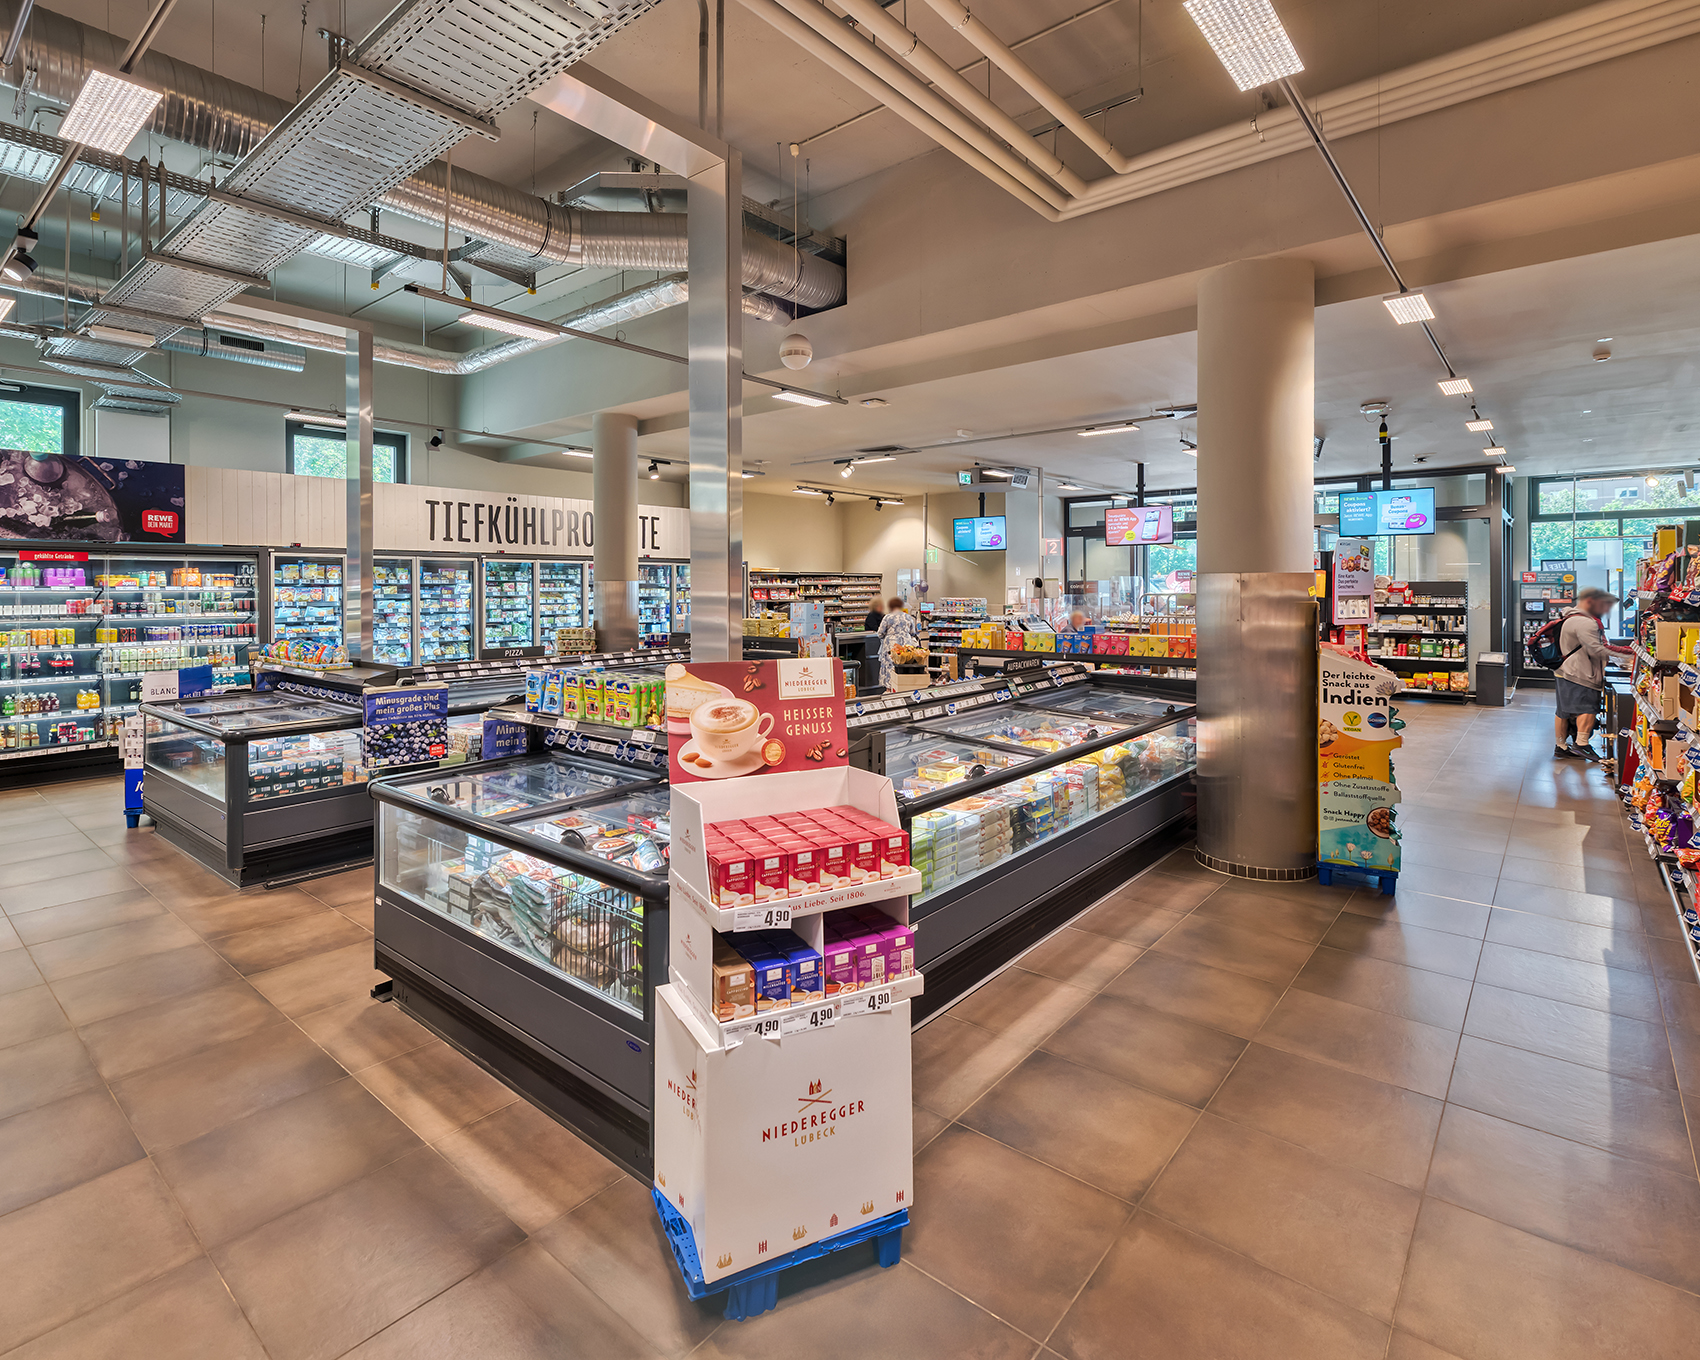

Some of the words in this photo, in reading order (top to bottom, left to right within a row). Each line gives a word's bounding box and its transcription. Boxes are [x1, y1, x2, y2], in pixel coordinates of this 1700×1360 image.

[148, 514, 173, 522] REWE
[1050, 542, 1058, 554] 2
[930, 552, 933, 561] 1
[1323, 670, 1340, 678] Der
[1343, 672, 1376, 680] leichte
[784, 679, 827, 687] NIEDEREGGER
[1322, 679, 1351, 687] Snack
[376, 694, 421, 705] Minusgrade
[1323, 688, 1387, 706] Indien
[376, 706, 395, 714] mein
[397, 704, 422, 715] großes
[784, 707, 833, 721] HEISSER
[786, 722, 832, 736] GENUSS
[496, 737, 520, 747] mein
[1333, 762, 1365, 770] Glutenfrei
[1352, 783, 1389, 792] Zusatzstoffe
[1334, 791, 1386, 801] Ballaststoffquelle
[1344, 810, 1365, 819] Happy
[804, 900, 827, 908] Liebe.
[830, 894, 844, 904] Seit
[847, 890, 866, 900] 1806.
[764, 910, 789, 926] 4.90
[868, 993, 889, 1010] 4.90
[810, 1008, 832, 1027] 4.90
[754, 1020, 778, 1036] 4.90
[762, 1100, 865, 1142] NIEDEREGGER
